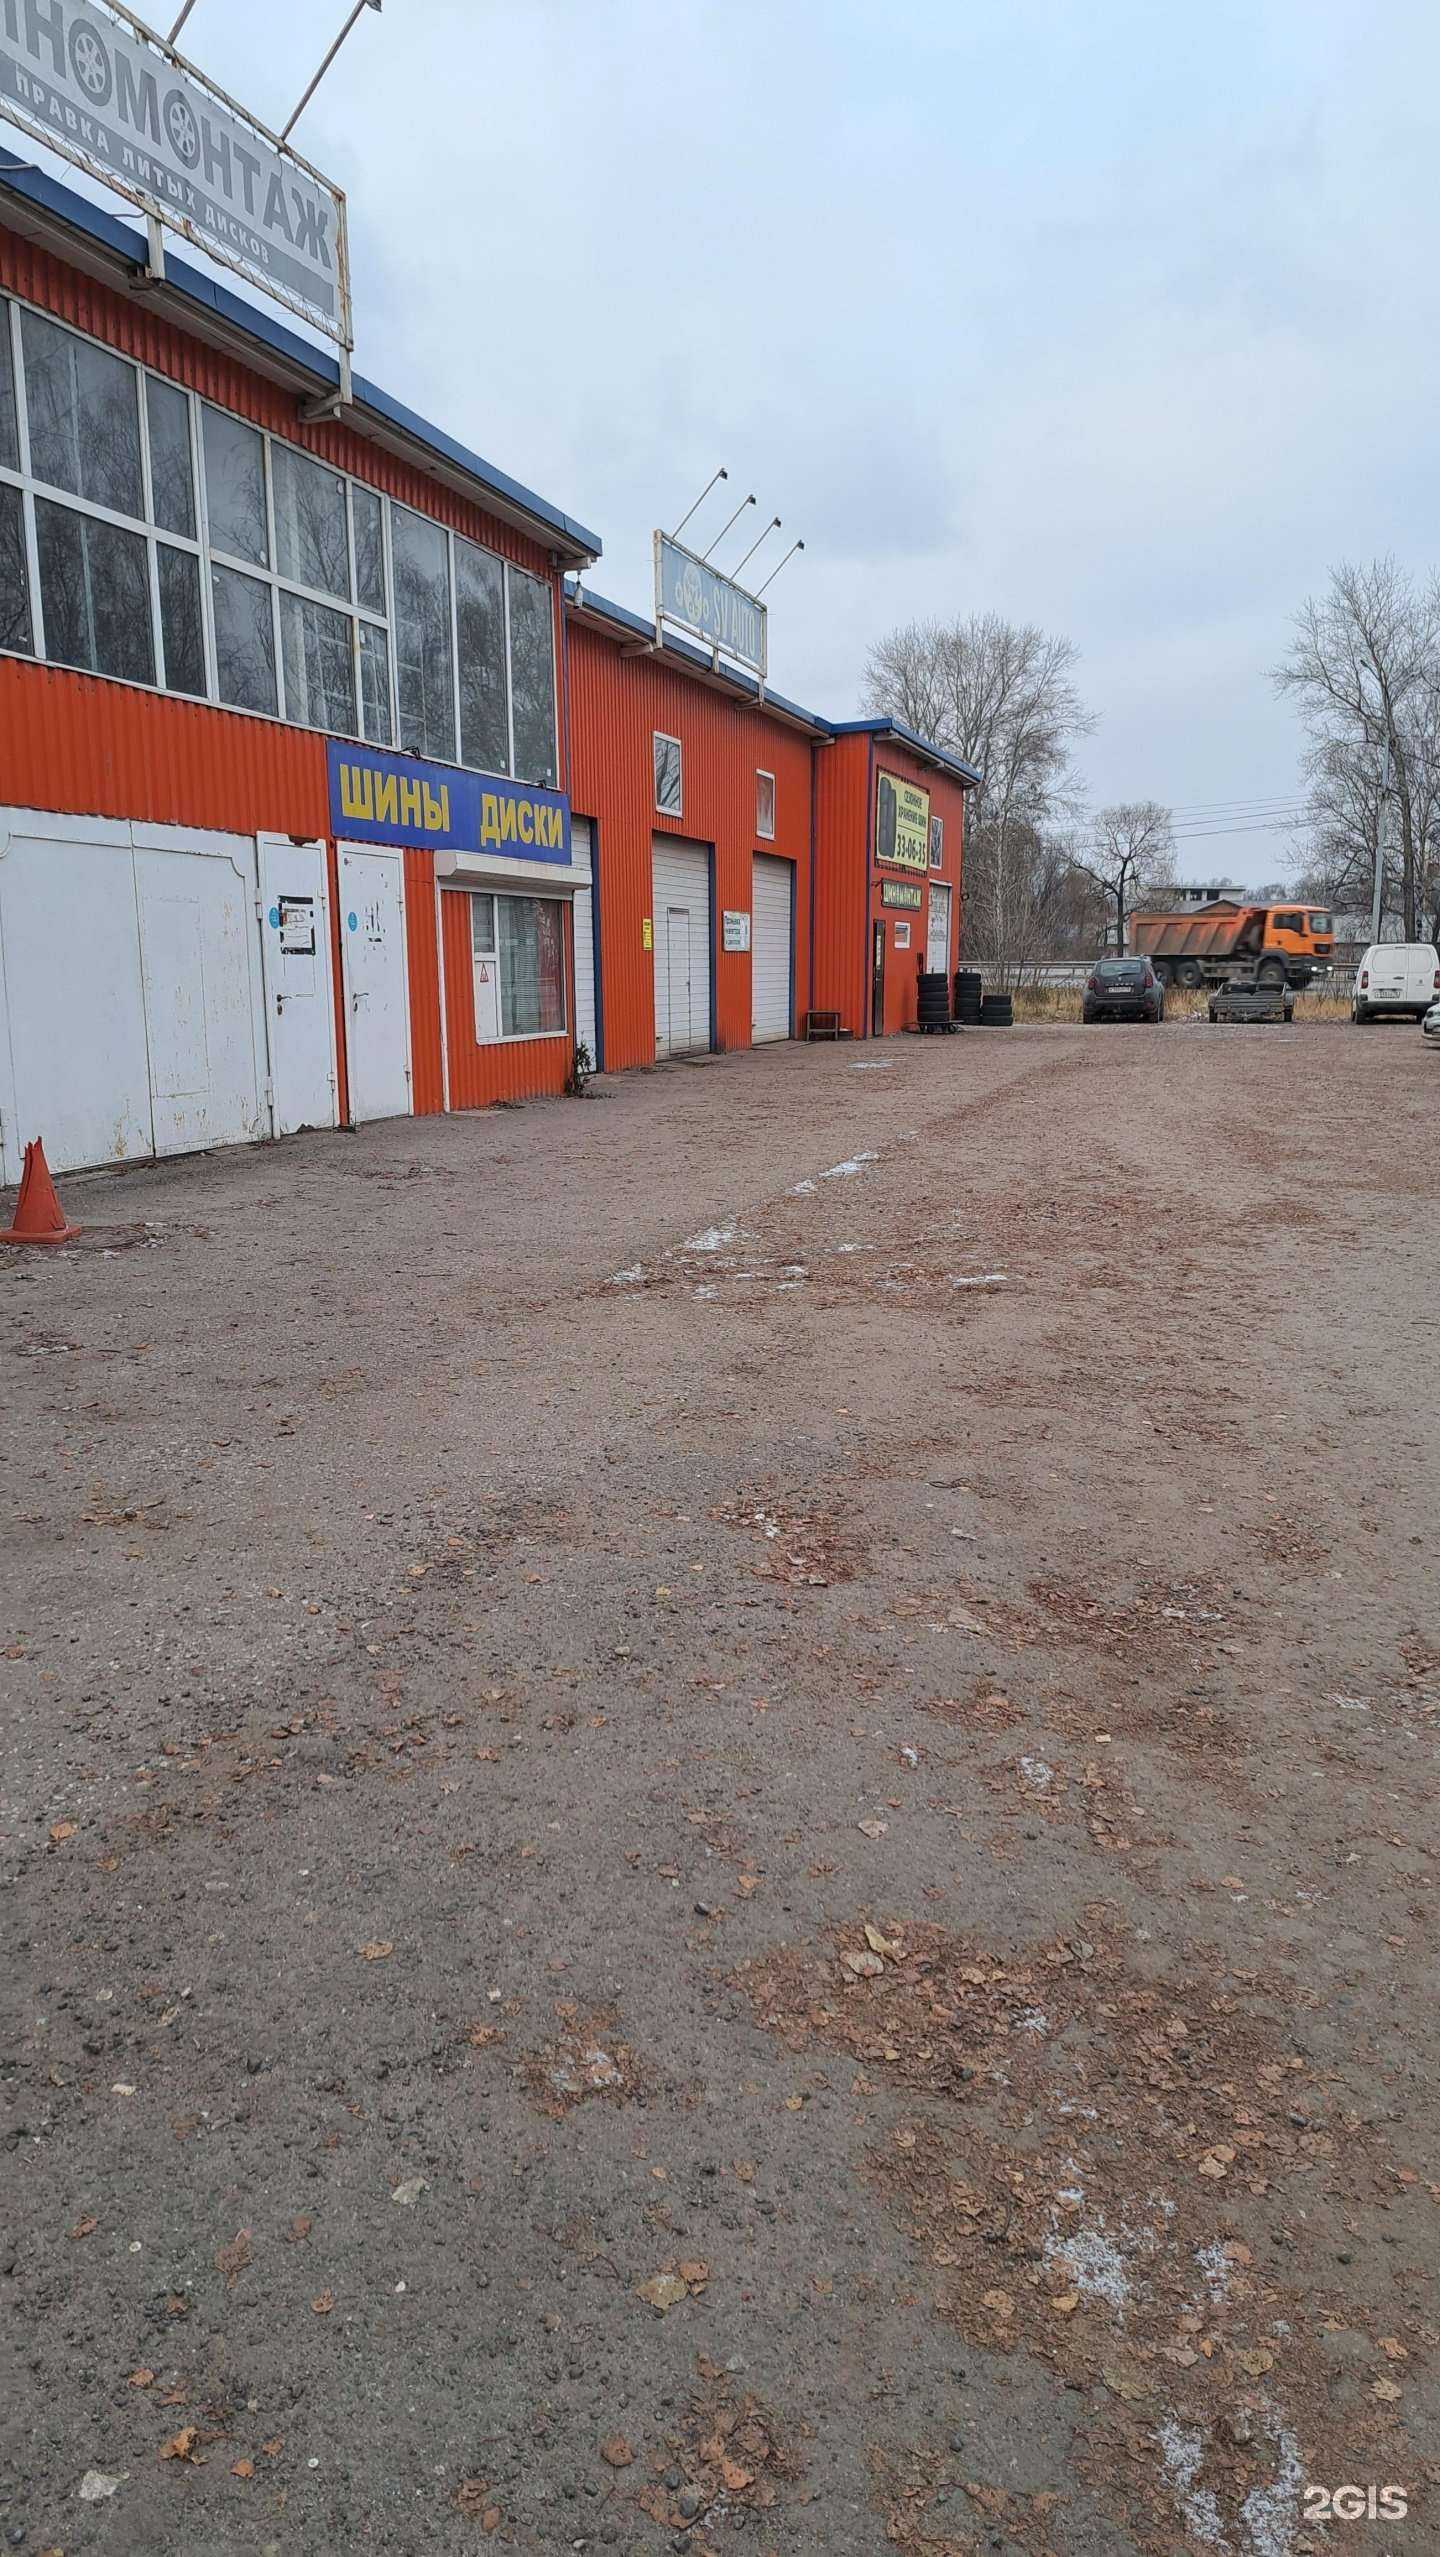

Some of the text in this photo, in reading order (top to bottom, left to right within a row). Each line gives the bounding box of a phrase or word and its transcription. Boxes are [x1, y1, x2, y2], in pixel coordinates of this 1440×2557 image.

[15, 63, 271, 265] ПРАВКА ЛИТЫХ ДИСКОВ
[731, 595, 755, 658] AUTO
[339, 763, 564, 849] ШИНЫ ДИСКИ
